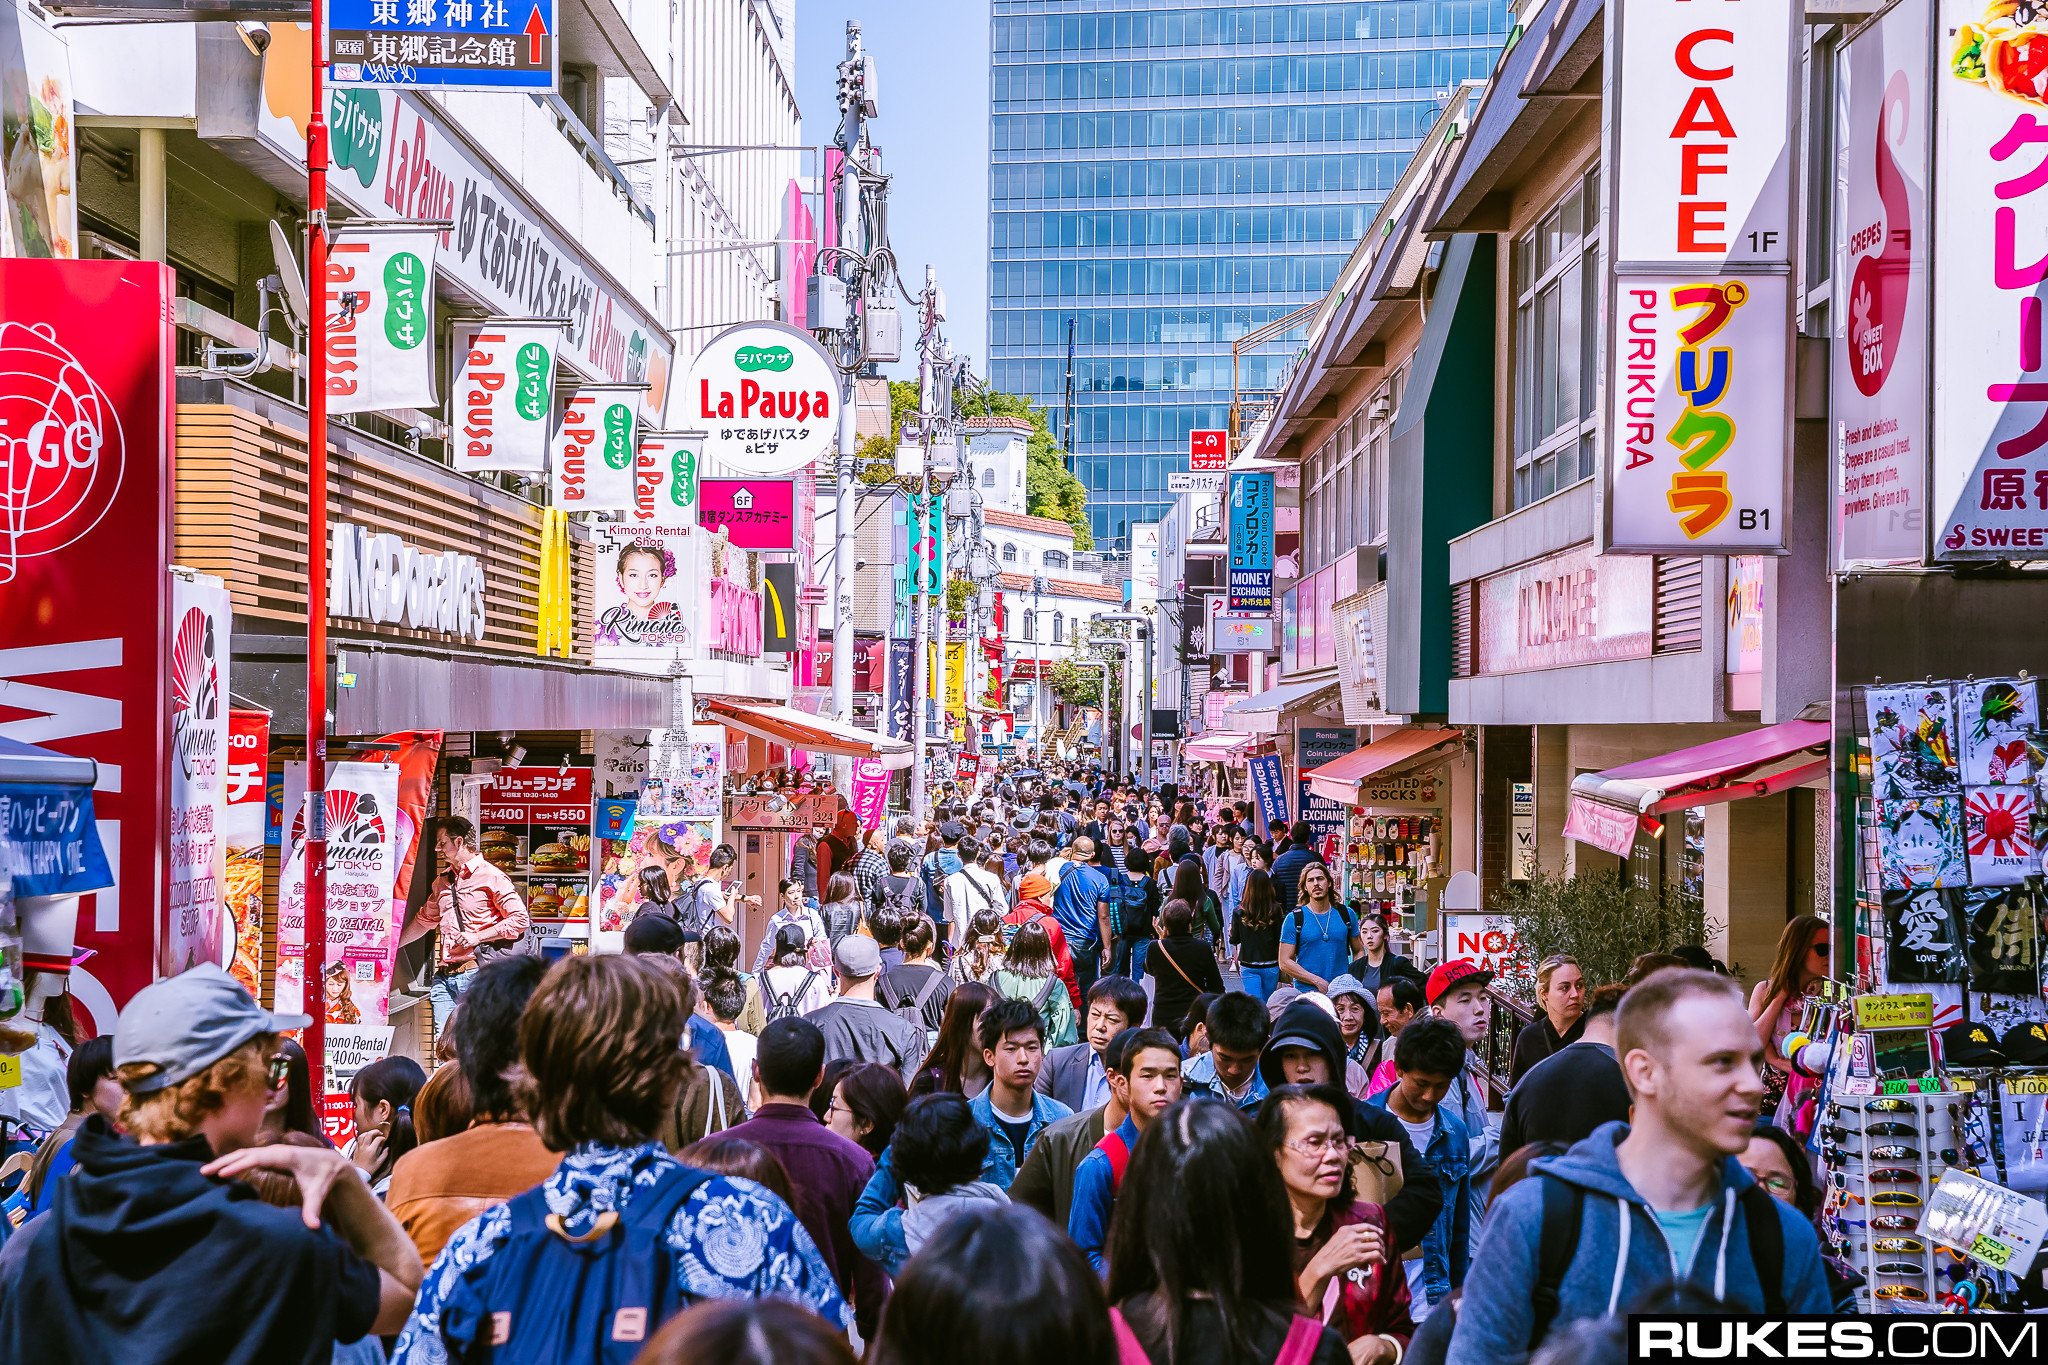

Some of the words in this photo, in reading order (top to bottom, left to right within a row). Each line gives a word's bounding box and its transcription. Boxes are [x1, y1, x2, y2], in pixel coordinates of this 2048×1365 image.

[370, 0, 509, 28] 東郷神社
[337, 41, 362, 54] 原宿
[370, 34, 517, 66] 東郷記念館
[333, 90, 382, 158] ラパウザ
[1669, 29, 1737, 252] CAFE
[1748, 232, 1778, 252] 1F
[1851, 221, 1881, 256] CREPES
[394, 256, 416, 347] ラパウザ
[1862, 324, 1883, 346] SWEET
[736, 352, 791, 365] ラパウザ
[1863, 343, 1883, 375] BOX
[525, 346, 541, 420] ラパウザ
[1625, 290, 1657, 470] PURIKURA
[1666, 280, 1749, 540] プリクラ
[612, 407, 625, 468] ラパウザ
[721, 428, 809, 440] ゆであげパスタ
[1845, 427, 1860, 446] Fresh
[1862, 423, 1872, 441] and
[1873, 418, 1899, 438] delicious.
[1845, 451, 1864, 471] Crepes
[1864, 449, 1873, 464] are
[1878, 440, 1896, 460] casual
[1897, 436, 1910, 455] treat.
[678, 453, 690, 506] ラパウザ
[1845, 475, 1860, 495] Enjoy
[1861, 472, 1874, 488] them
[1876, 465, 1899, 487] anytime,
[633, 472, 664, 523] Paus
[736, 495, 750, 506] 6F
[1261, 481, 1270, 509] Rental
[1845, 497, 1871, 519] anywhere.
[1246, 481, 1259, 566] コインロッカー
[1261, 511, 1270, 532] Coin
[1739, 508, 1769, 530] B1
[609, 525, 652, 536] Kimono
[656, 525, 690, 536] Rental
[598, 545, 614, 553] 3F
[635, 536, 664, 549] Shop
[1261, 536, 1270, 566] Locker
[330, 523, 485, 641] McDonald's
[1231, 573, 1270, 585] MONEY
[1231, 587, 1271, 596] EXCHANGE
[1241, 598, 1271, 606] 外币兑换
[600, 604, 686, 643] Kimono
[640, 633, 684, 642] TOKYO
[1301, 741, 1354, 749] コインロッカー
[191, 759, 216, 775] TOKYO
[611, 759, 644, 772] Paris
[483, 775, 576, 791] バリューランチ
[1371, 790, 1417, 800] SOCKS
[491, 809, 524, 820] ¥400
[553, 809, 585, 820] ¥550
[780, 816, 808, 826] ¥324
[813, 813, 833, 822] 324
[1302, 810, 1345, 821] EXCHANG
[335, 860, 382, 870] TOKYO
[1991, 857, 2024, 867] JAPAN
[193, 876, 216, 903] RENTAL
[181, 907, 199, 937] SHOP
[340, 917, 385, 931] RENTAL
[1899, 890, 1952, 951] 愛
[1986, 896, 2039, 965] 侍
[326, 931, 354, 943] HOP
[1916, 954, 1937, 962] LOVE
[1866, 1002, 1899, 1010] サングラス
[1865, 1013, 1905, 1022] タイムセール
[325, 1037, 350, 1049] mono
[352, 1036, 387, 1051] Rental
[1884, 1081, 1908, 1094] ¥500
[1972, 1241, 2006, 1266] ¥3000
